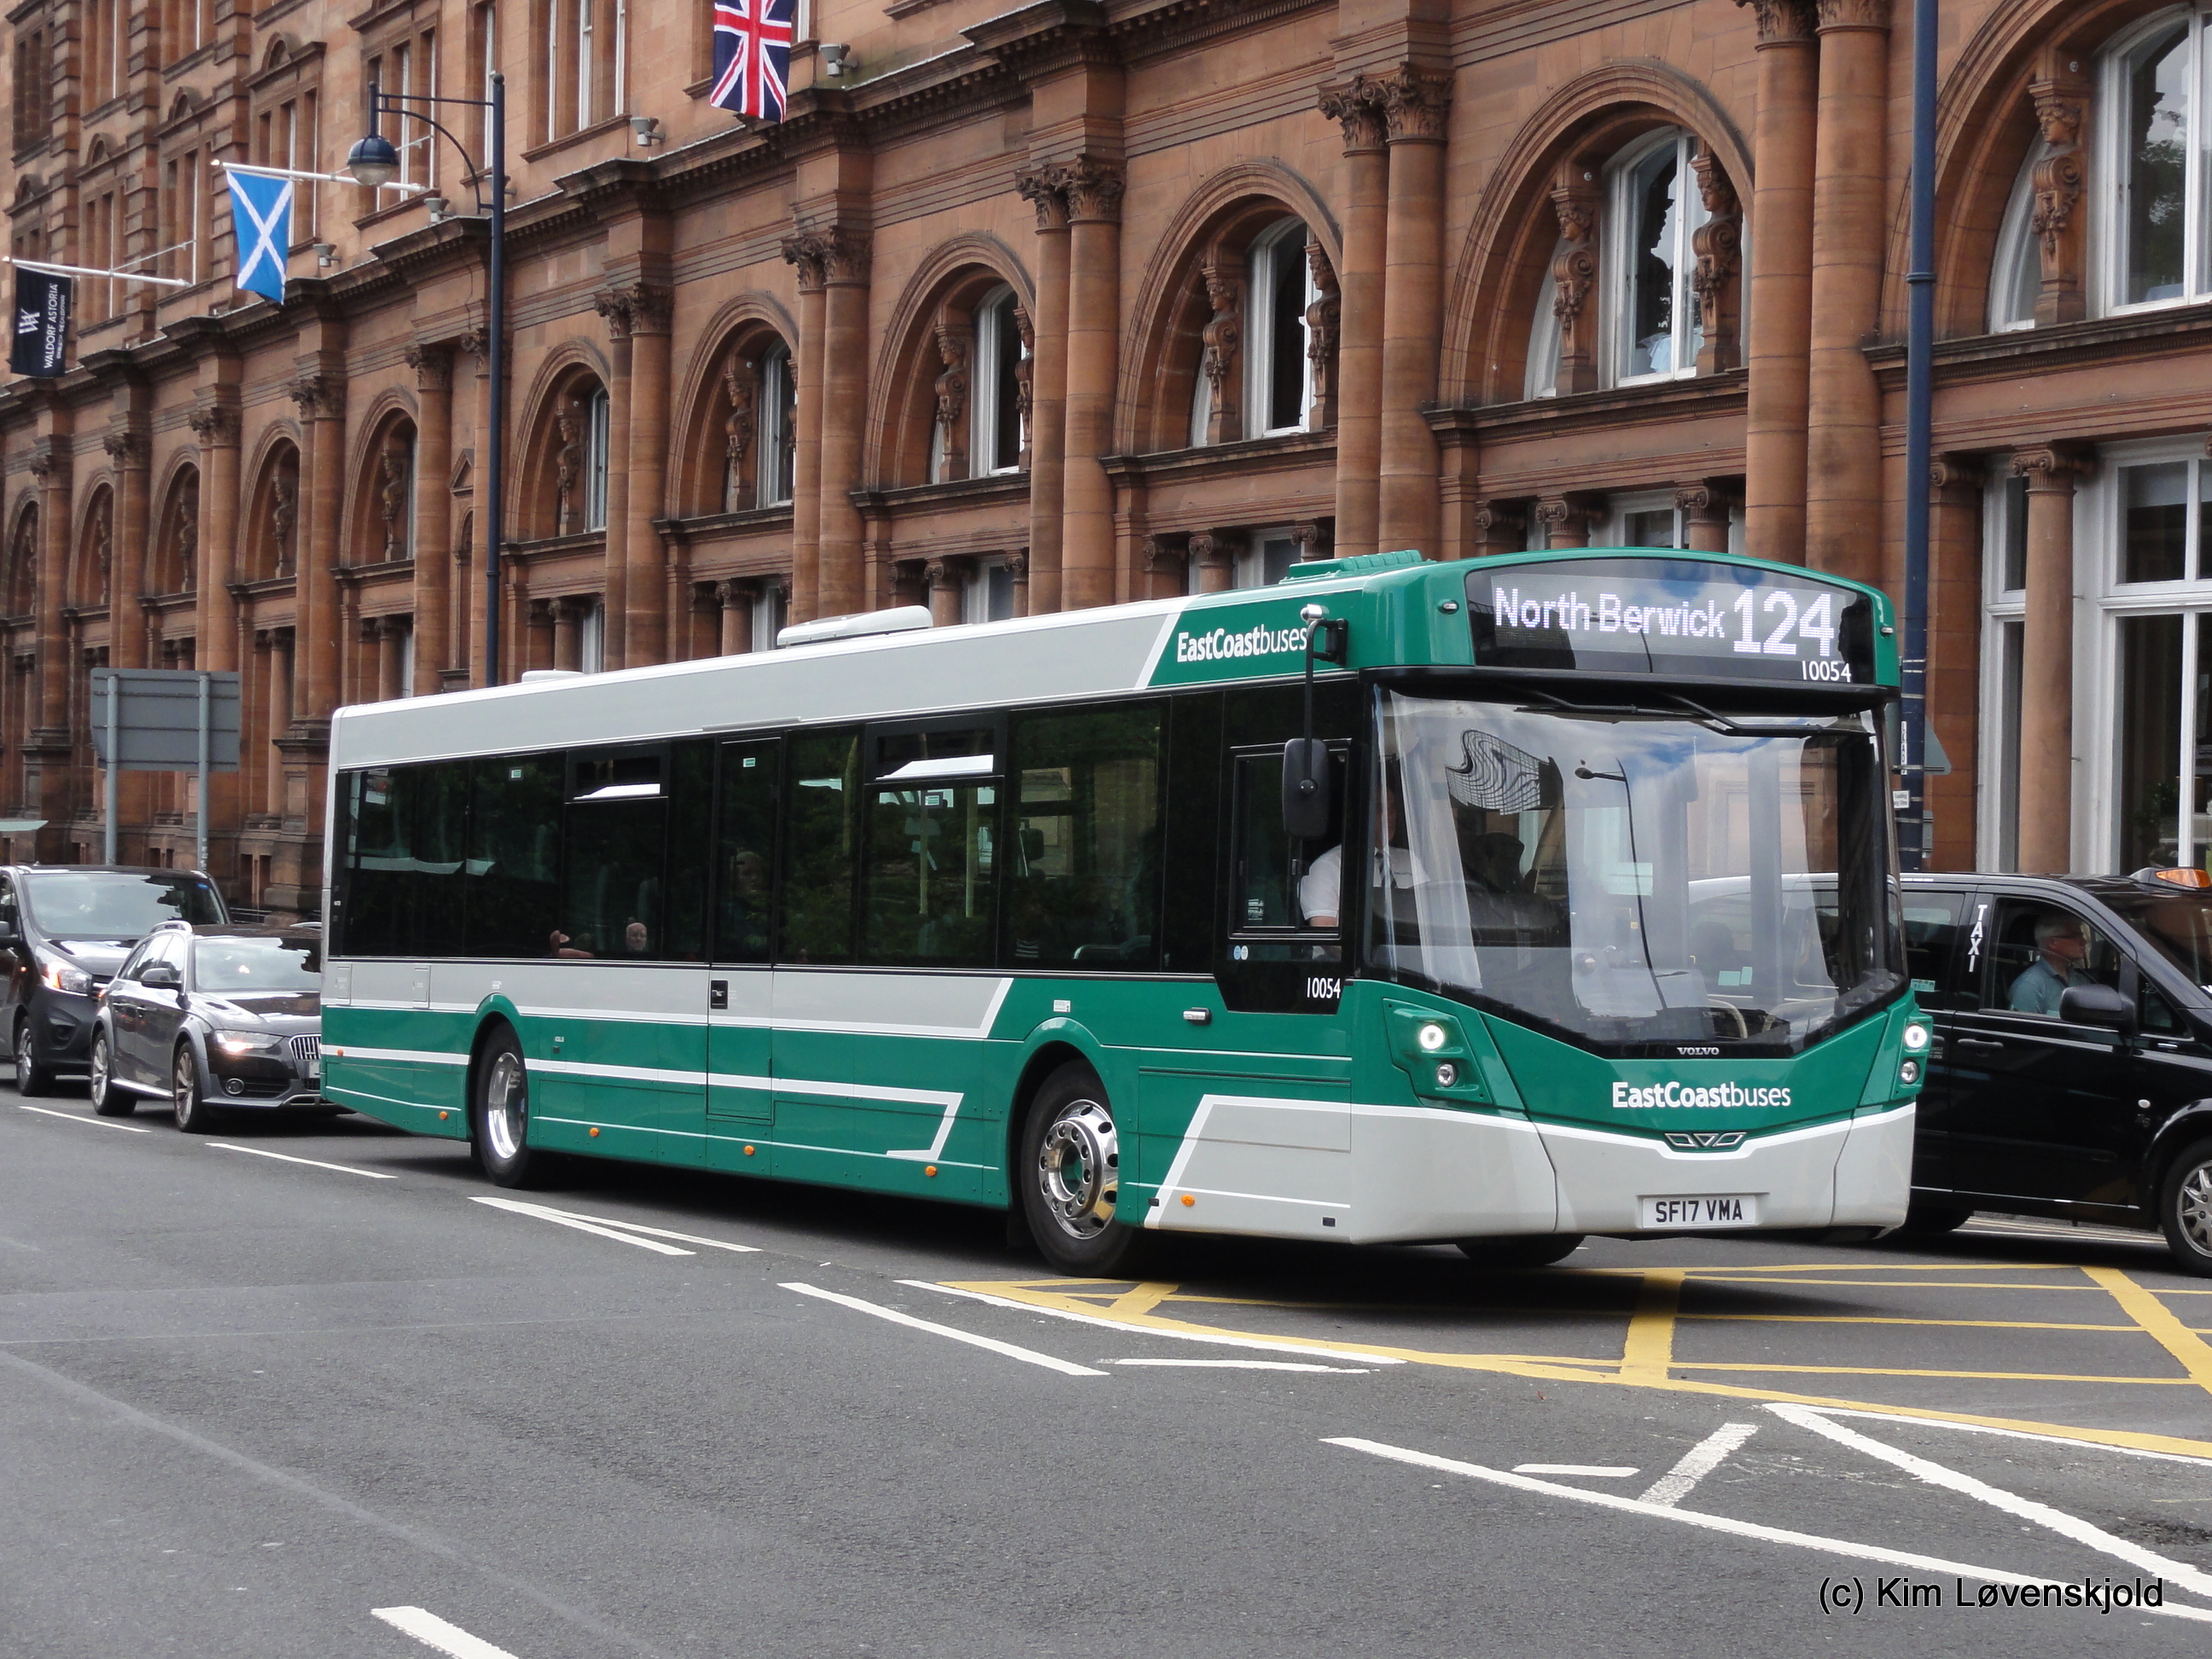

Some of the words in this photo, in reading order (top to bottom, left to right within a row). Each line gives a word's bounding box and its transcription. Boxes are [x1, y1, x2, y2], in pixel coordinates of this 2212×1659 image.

[48, 283, 58, 323] ASTORIA
[44, 323, 55, 369] WALDORF
[1495, 587, 1590, 631] North
[1598, 593, 1725, 638] Berwick
[1733, 589, 1835, 656] 124
[1177, 624, 1307, 662] EastCoastbuses
[1802, 661, 1852, 683] 10054
[1968, 904, 1988, 973] TAXI
[1307, 977, 1341, 998] 10054
[1677, 1046, 1720, 1056] VOLVO
[1612, 1081, 1791, 1108] EastCoastbuses
[1656, 1200, 1699, 1223] SF17
[1706, 1199, 1743, 1221] VMA
